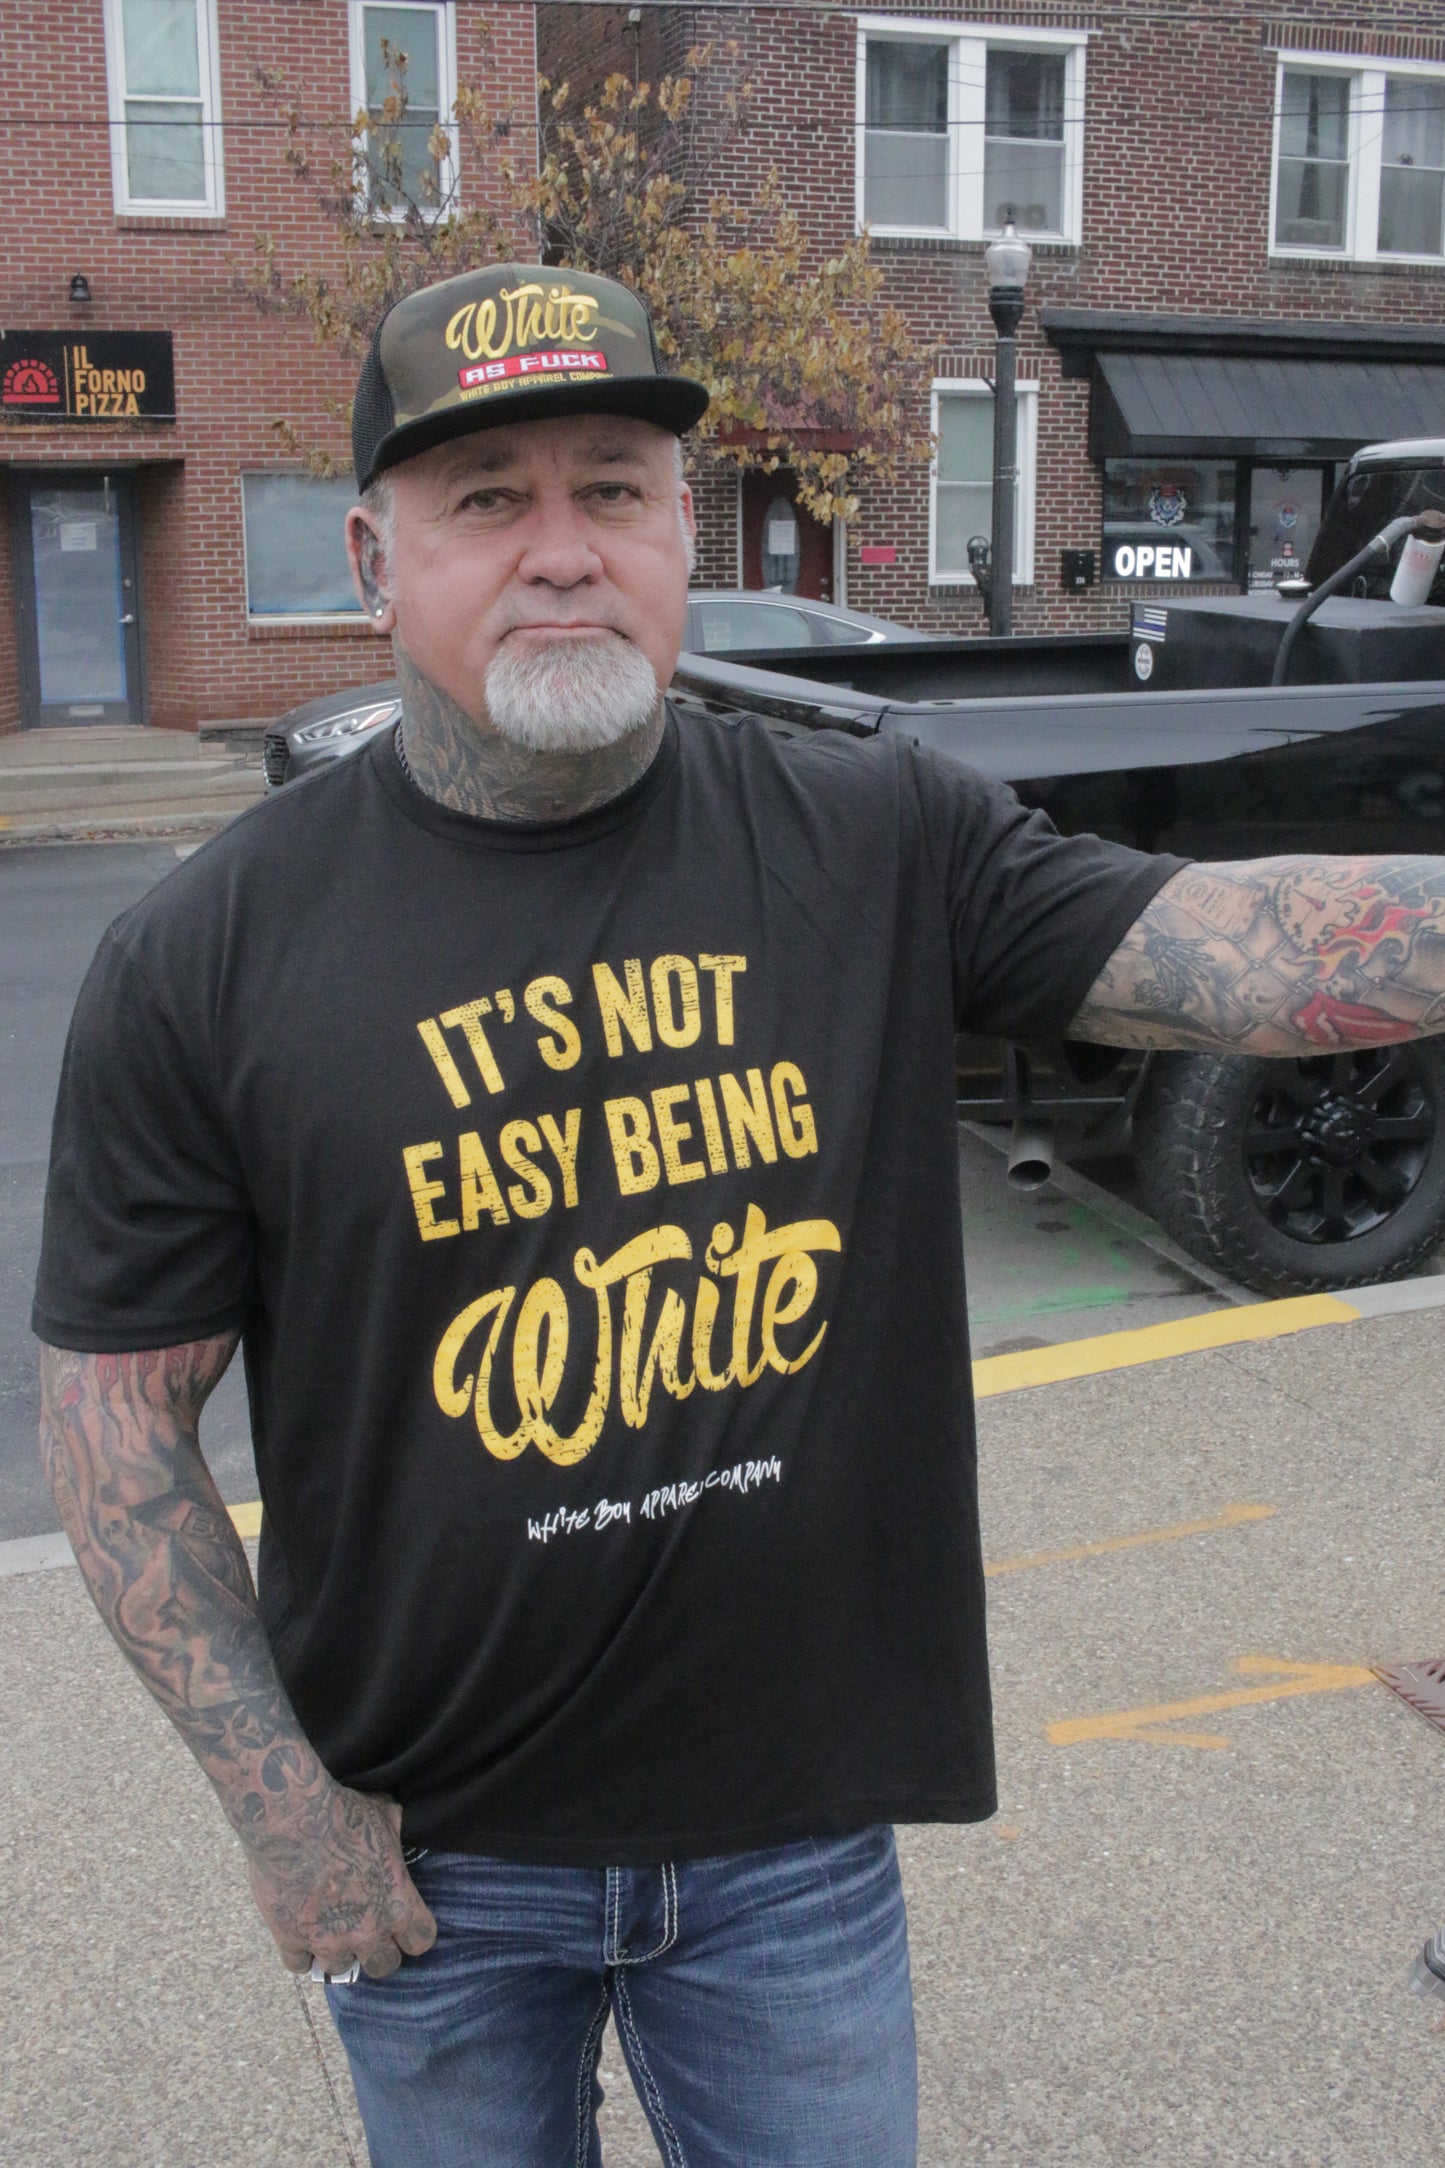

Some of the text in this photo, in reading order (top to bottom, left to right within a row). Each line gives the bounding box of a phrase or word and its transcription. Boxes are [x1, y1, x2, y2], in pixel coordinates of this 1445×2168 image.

[445, 284, 599, 360] White
[73, 345, 94, 369] IL
[465, 354, 600, 384] AS FUCK
[74, 369, 146, 393] FORNO
[460, 385, 491, 401] WHITE
[493, 379, 515, 392] BOY
[519, 372, 567, 386] APPAREL
[76, 393, 140, 416] PIZZA
[1115, 545, 1192, 578] OPEN
[1271, 558, 1299, 567] HOURS
[417, 954, 747, 1109] IT'S NOT
[403, 1061, 819, 1242] EASY BEING
[433, 1203, 841, 1467] White
[705, 1455, 781, 1494] COMPANY
